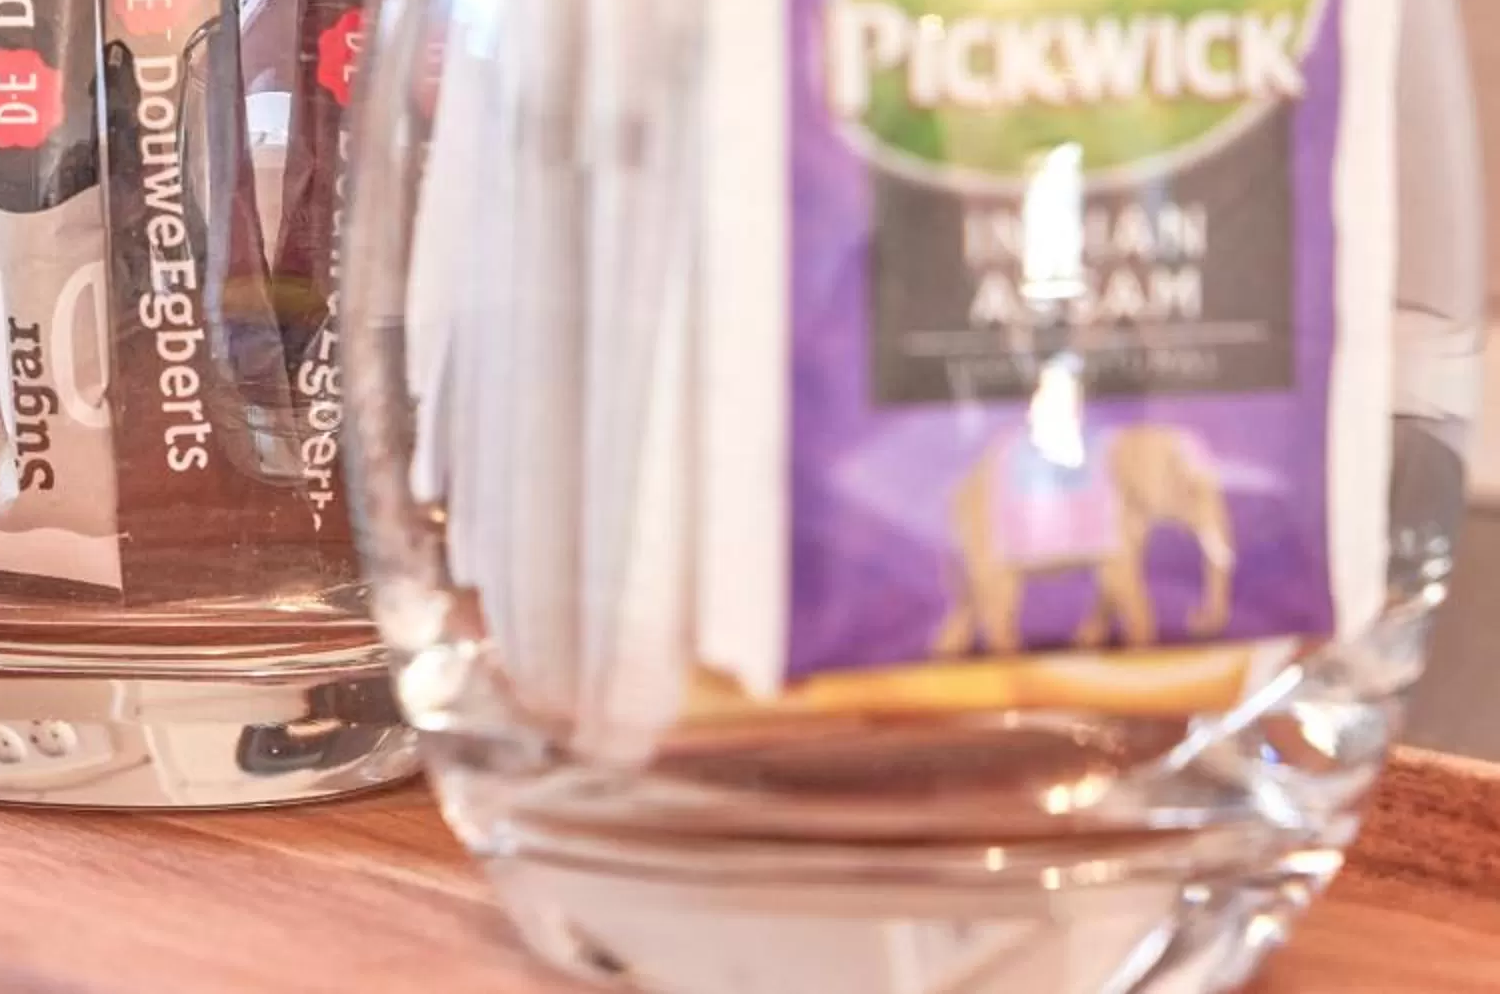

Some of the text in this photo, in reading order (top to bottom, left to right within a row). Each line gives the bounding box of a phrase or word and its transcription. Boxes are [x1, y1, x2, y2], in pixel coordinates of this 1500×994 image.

[832, 2, 1304, 117] PICKWICK
[134, 55, 212, 473] Douwe Egberts
[963, 204, 1207, 265] INIAN
[8, 316, 59, 491] Sugar
